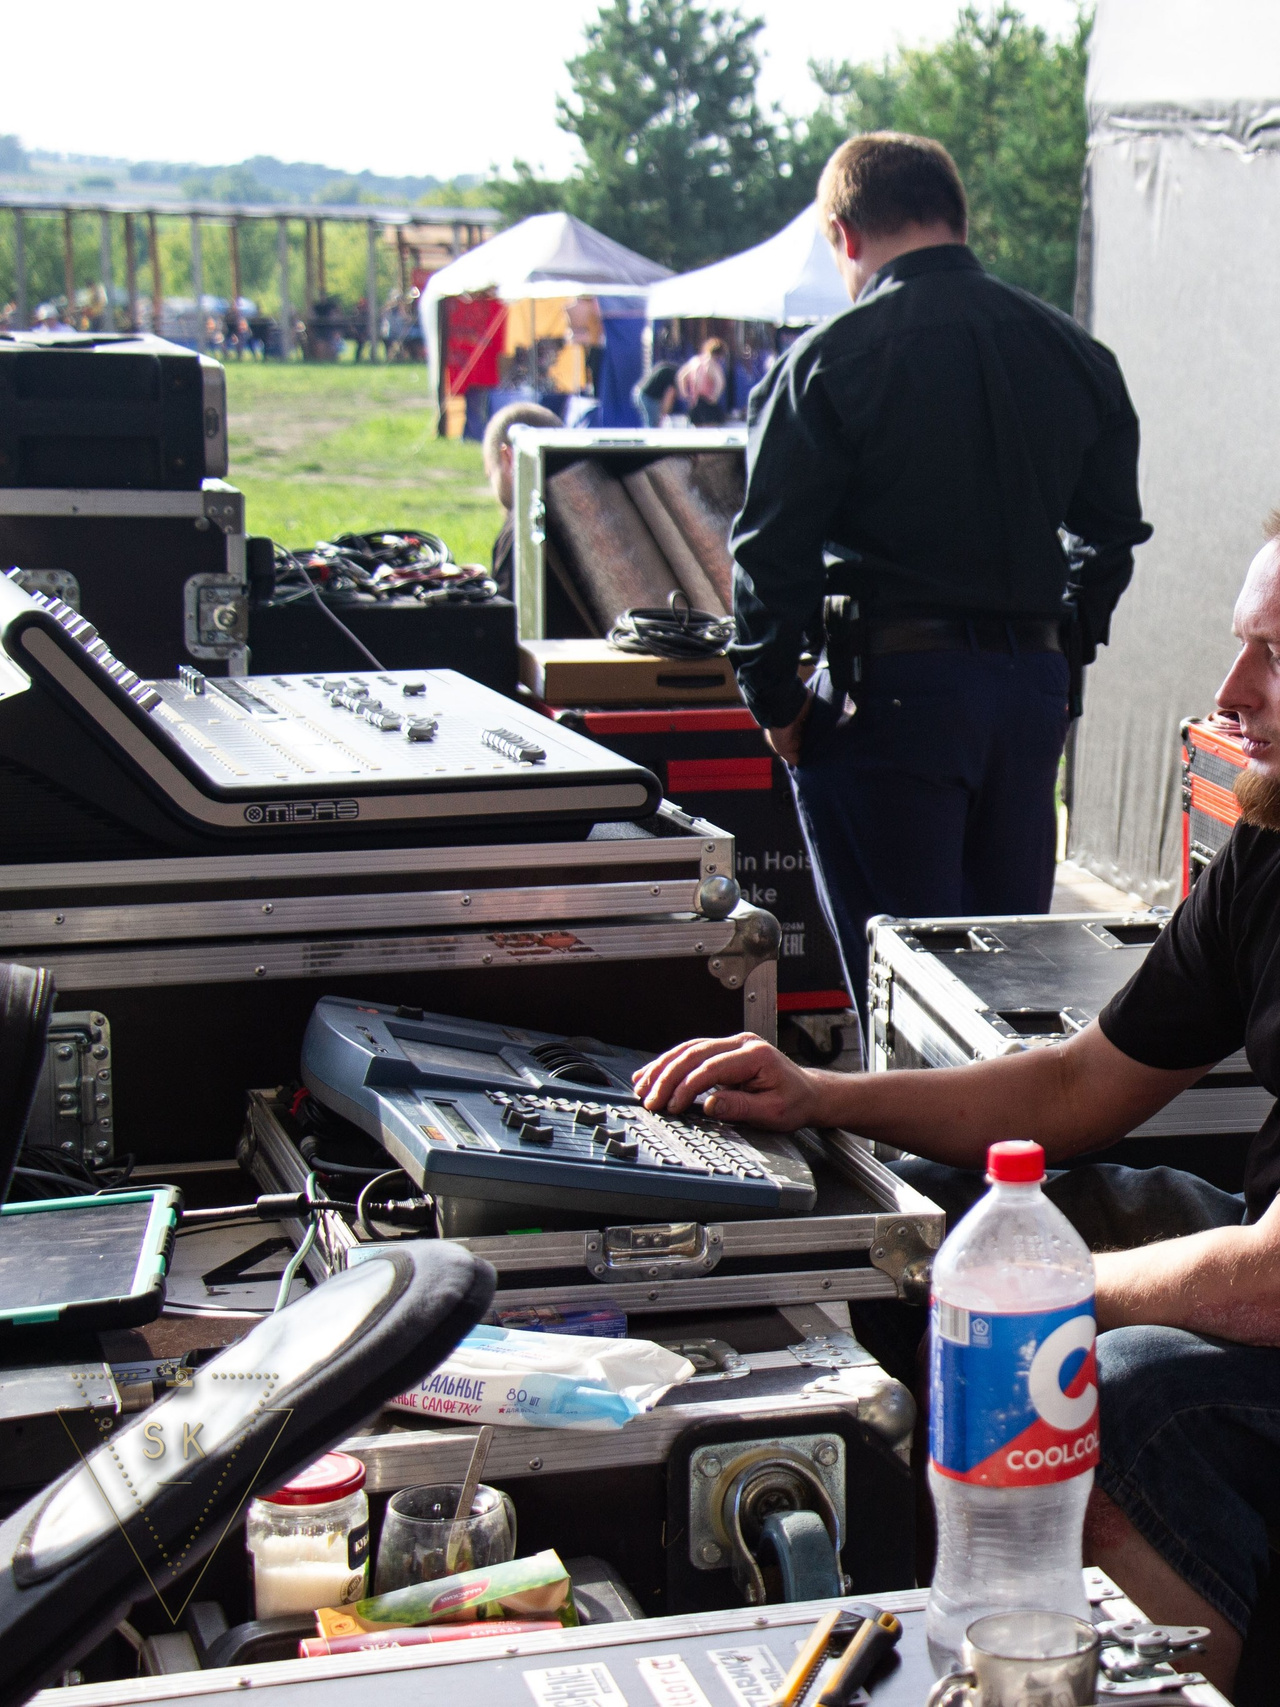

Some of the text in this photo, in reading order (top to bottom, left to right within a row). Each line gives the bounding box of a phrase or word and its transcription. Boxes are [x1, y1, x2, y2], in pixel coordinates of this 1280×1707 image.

[764, 849, 812, 870] Hois
[740, 883, 778, 903] ake
[421, 1374, 486, 1402] САЛЬНЫЕ
[506, 1387, 528, 1403] 80
[421, 1395, 482, 1416] САЛФЕТКИ
[1006, 1429, 1099, 1471] COOLCOL
[470, 1625, 522, 1638] КАРКАДЭ
